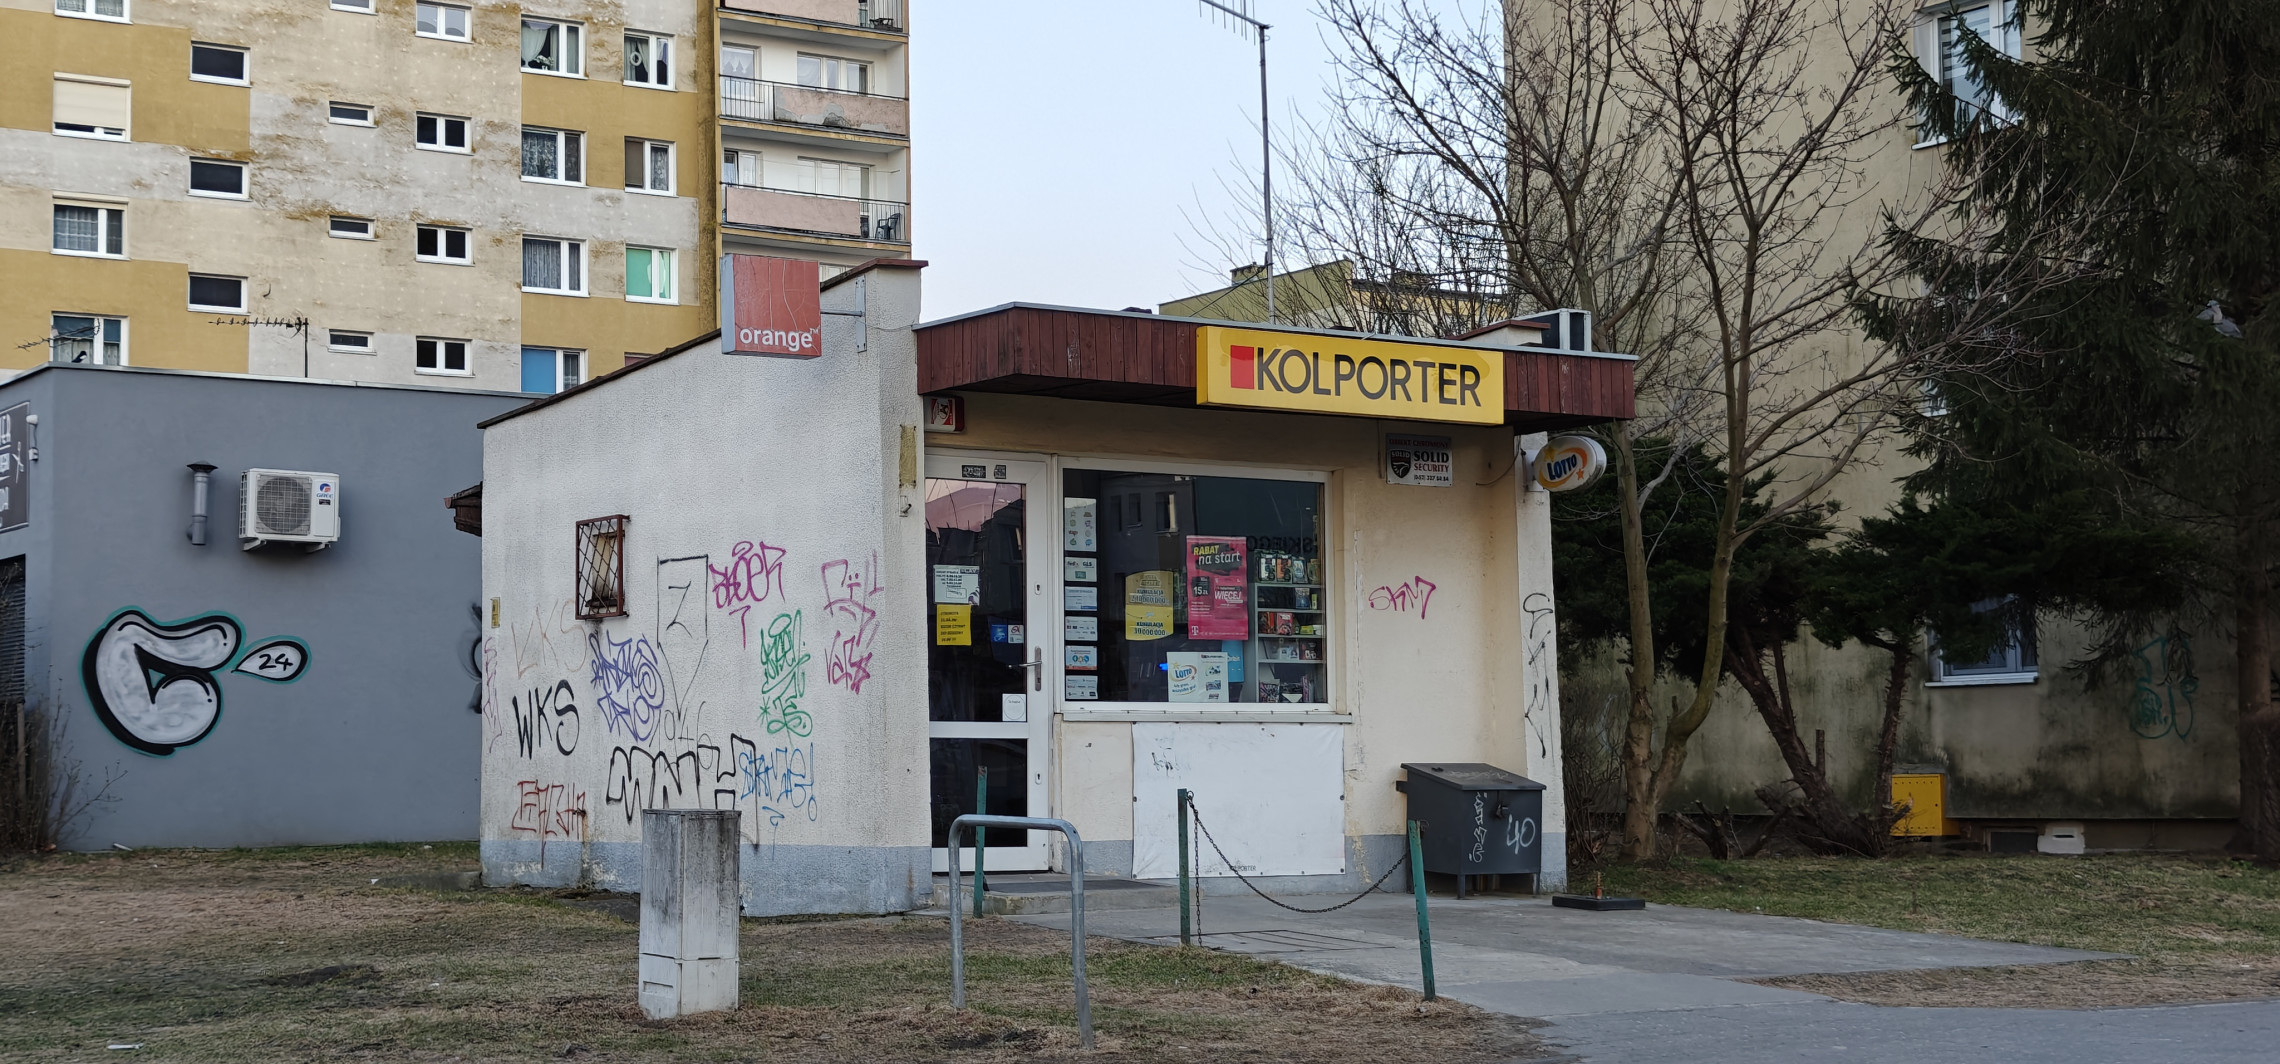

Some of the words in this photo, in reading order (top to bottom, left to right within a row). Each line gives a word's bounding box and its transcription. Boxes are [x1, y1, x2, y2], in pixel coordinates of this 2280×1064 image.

[740, 328, 813, 352] orange
[1257, 346, 1482, 407] KOLPORTER
[1413, 450, 1450, 463] SOLID
[1413, 463, 1450, 473] SECURITY
[1546, 454, 1578, 481] LOTTO
[1193, 545, 1220, 556] RABAT
[1198, 555, 1212, 566] na
[1214, 551, 1240, 563] start
[1193, 586, 1203, 595] 15
[259, 652, 294, 671] 24
[512, 679, 580, 761] WKS
[1506, 814, 1536, 855] 40
